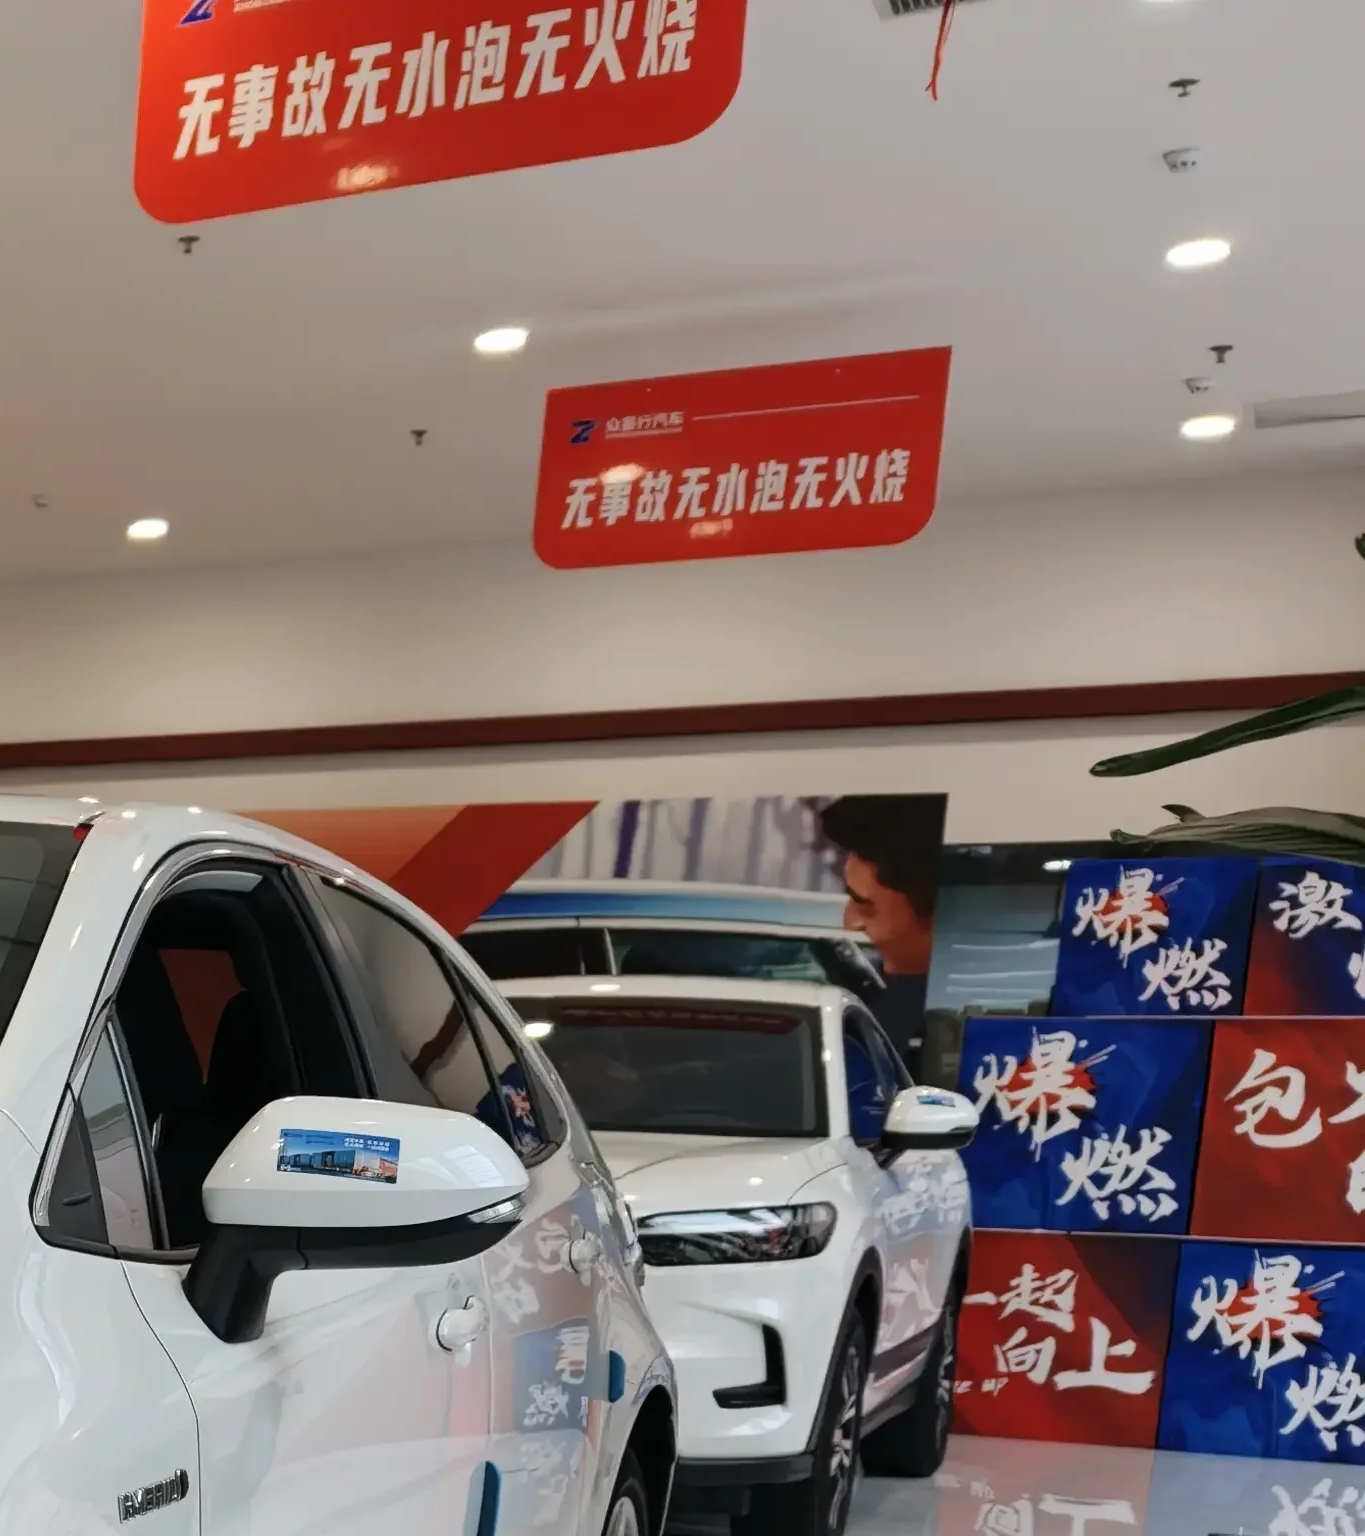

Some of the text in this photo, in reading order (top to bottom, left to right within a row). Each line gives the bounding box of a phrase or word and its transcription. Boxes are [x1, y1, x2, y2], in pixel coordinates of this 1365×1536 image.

[173, 0, 698, 160] 无事故无水泡无火烧
[561, 448, 911, 530] 无事故无水泡无火烧
[963, 1263, 1078, 1335] 一起
[993, 1316, 1156, 1396] 向上
